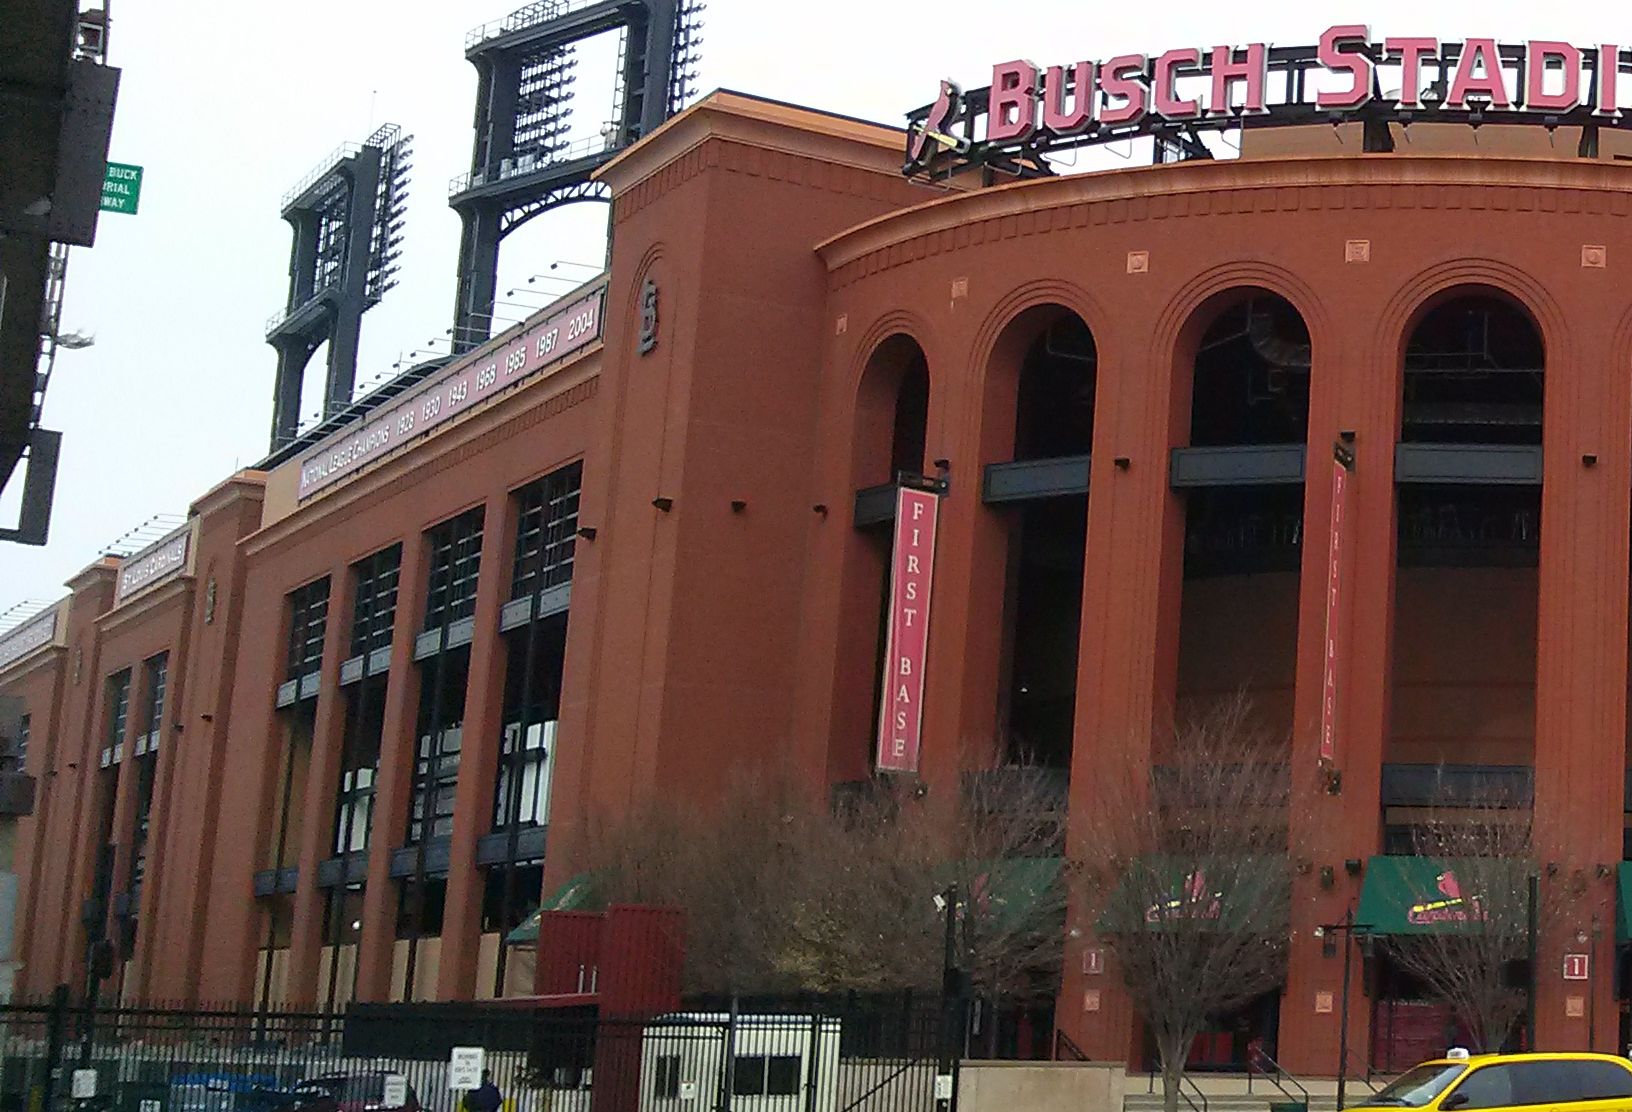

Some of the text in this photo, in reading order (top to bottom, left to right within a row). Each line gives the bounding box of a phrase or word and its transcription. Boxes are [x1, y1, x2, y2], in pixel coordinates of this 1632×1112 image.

[986, 43, 1272, 143] BUSCH
[109, 167, 138, 180] BUCK
[448, 381, 468, 407] 1943
[476, 364, 497, 391] 1968
[505, 347, 527, 375] 1985
[536, 328, 560, 358] 1987
[567, 309, 594, 341] 2004
[891, 502, 924, 757] FIRST BASE
